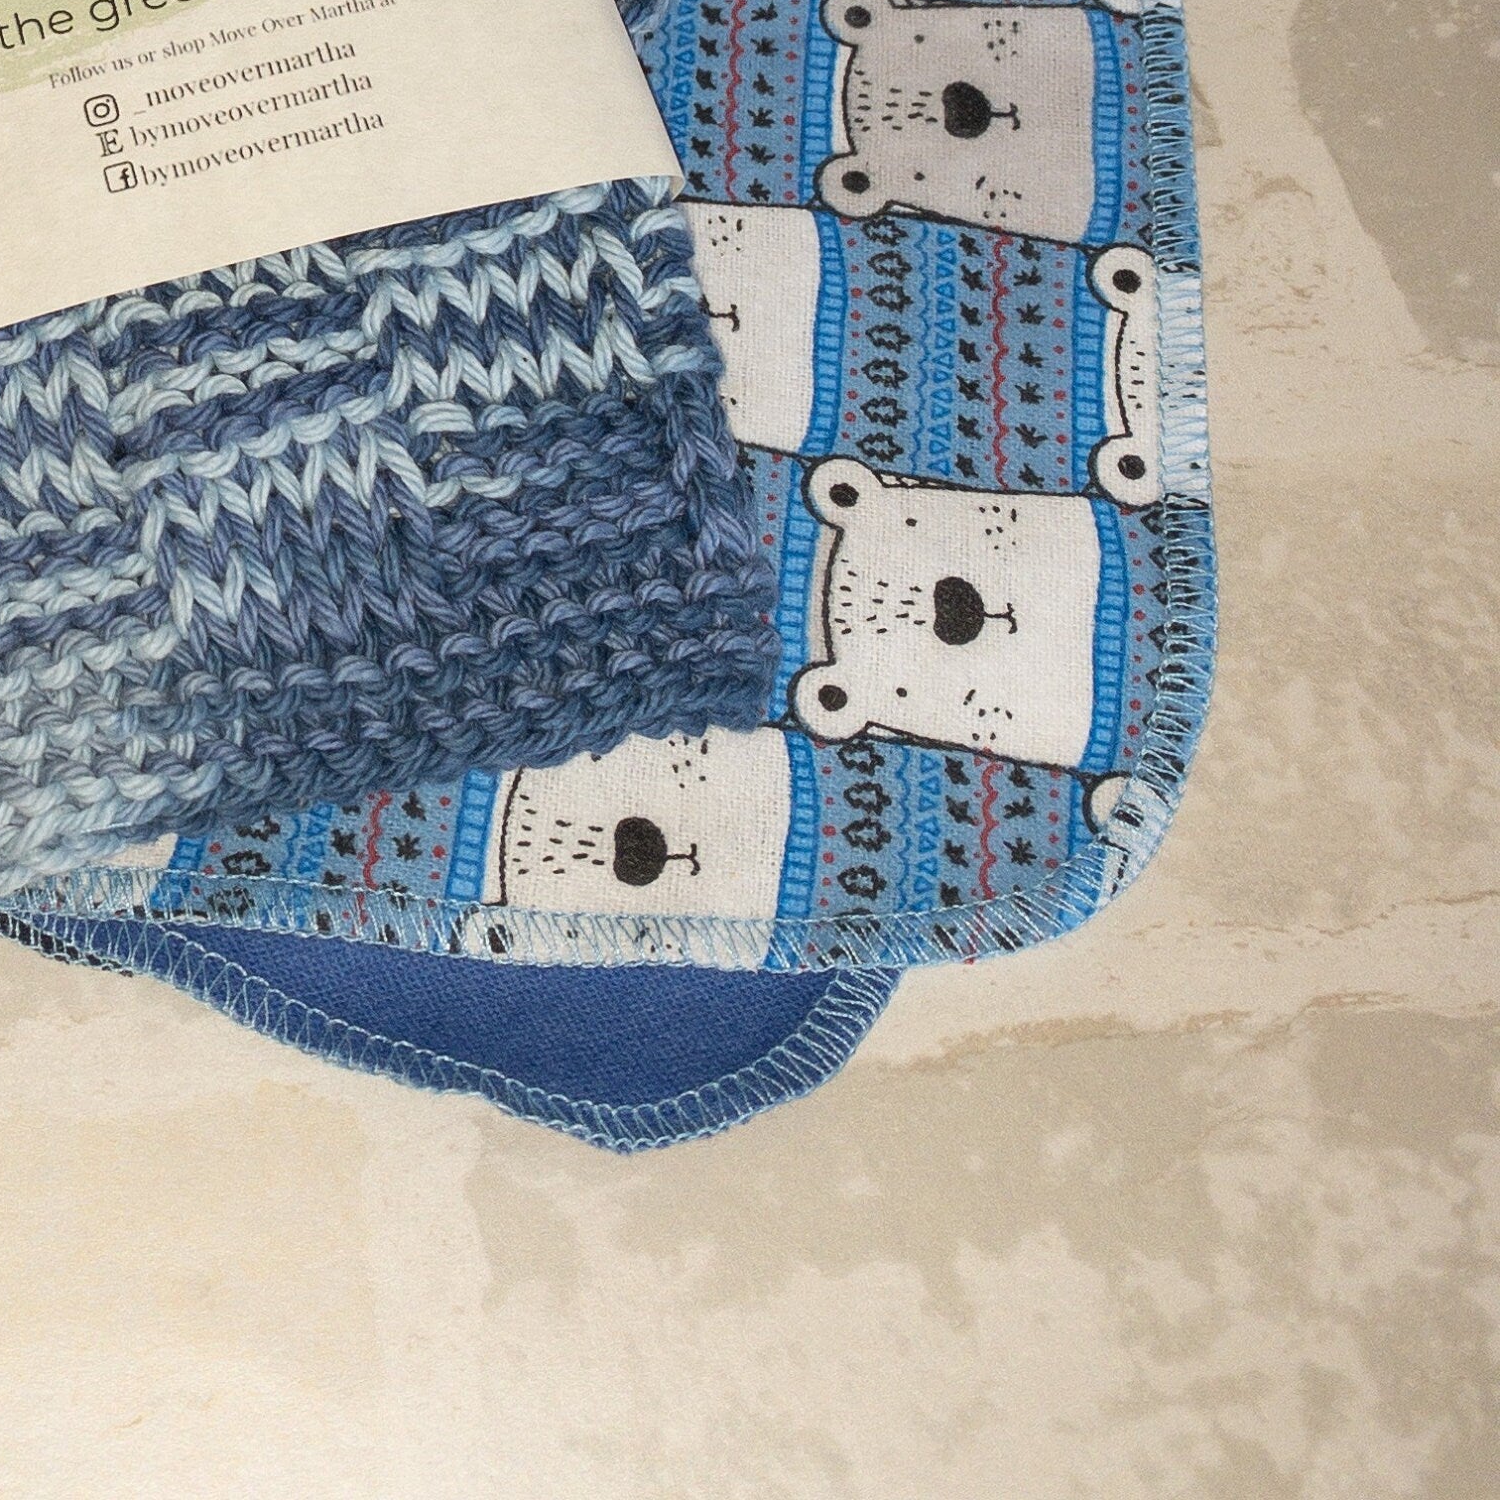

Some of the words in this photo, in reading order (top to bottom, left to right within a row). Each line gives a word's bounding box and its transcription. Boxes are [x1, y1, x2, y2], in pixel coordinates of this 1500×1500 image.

[48, 59, 108, 89] Follow
[112, 56, 134, 72] us
[138, 49, 157, 65] or
[162, 34, 206, 60] shop
[209, 23, 257, 48] Move
[262, 13, 305, 34] Over
[131, 71, 373, 147] bymoveovermartha
[142, 110, 385, 188] bymoveovermartha
